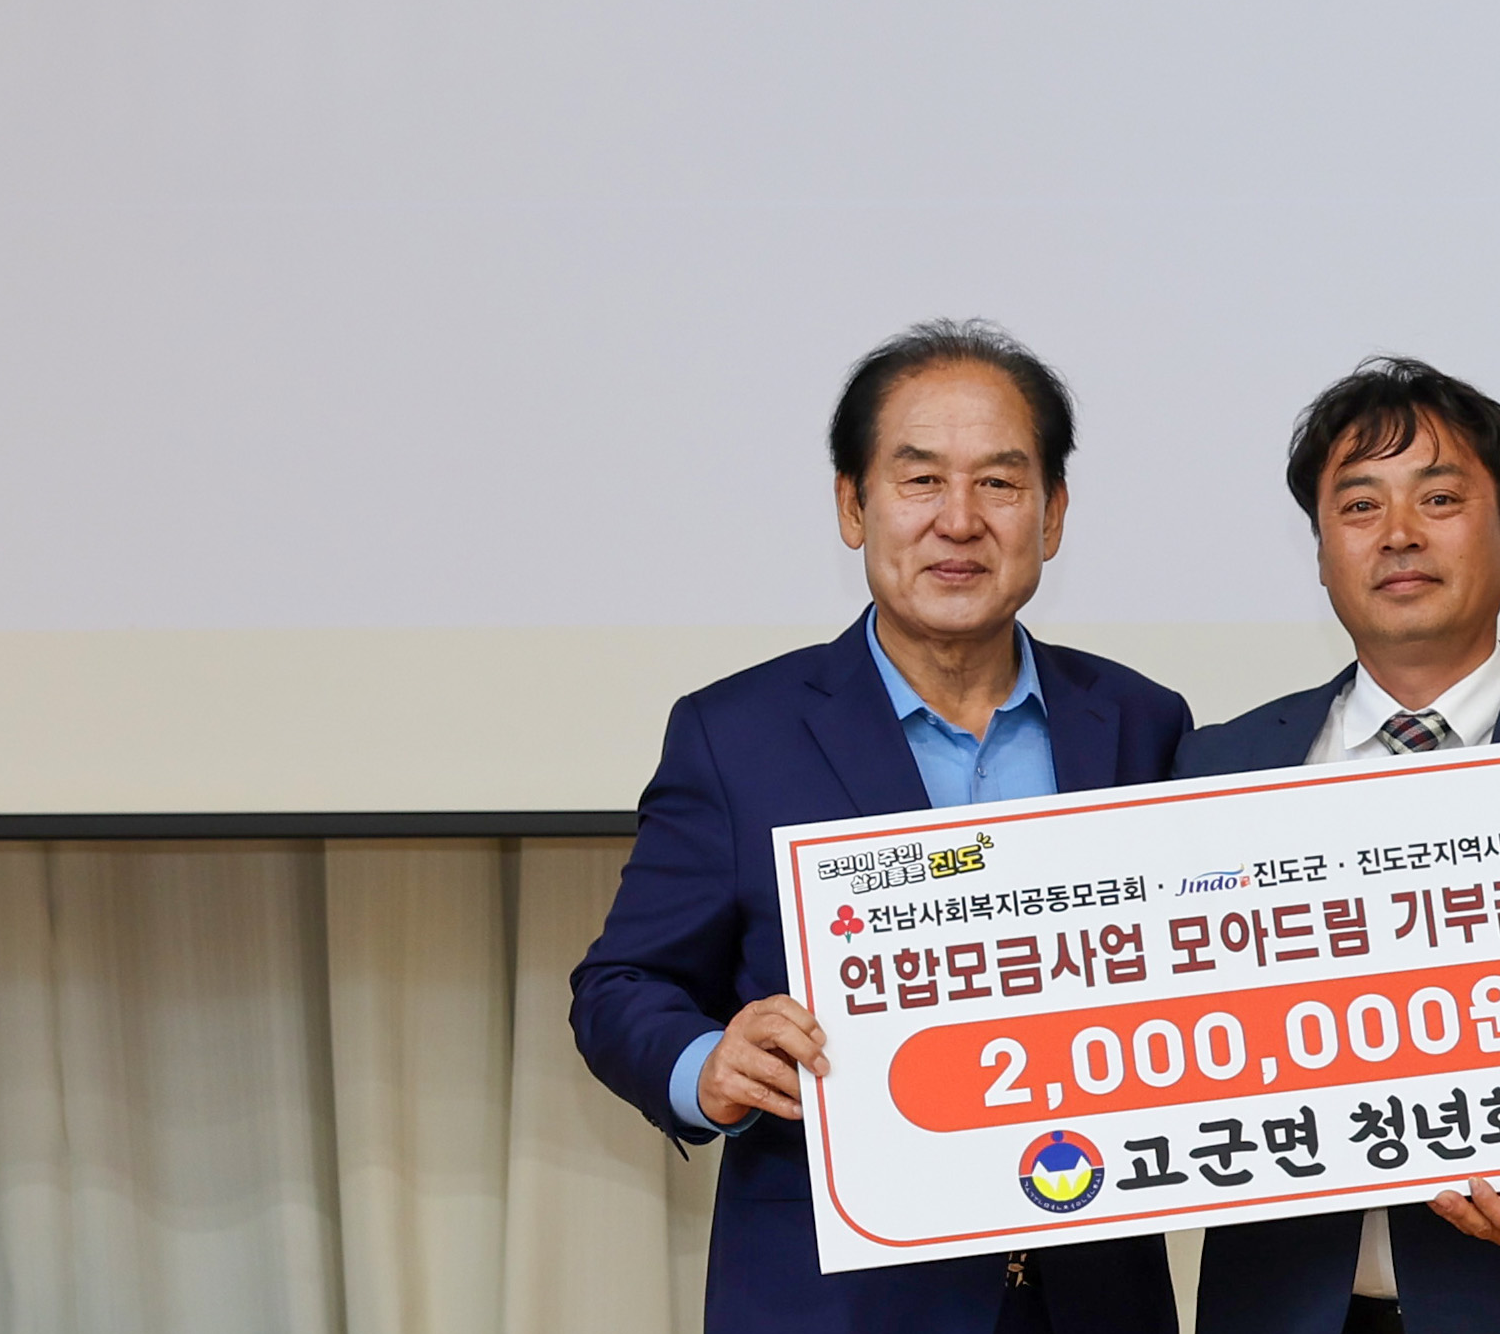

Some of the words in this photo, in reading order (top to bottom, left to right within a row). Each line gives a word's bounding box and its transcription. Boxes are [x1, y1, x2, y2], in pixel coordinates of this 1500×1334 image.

[818, 851, 875, 880] 군민이
[878, 842, 923, 866] 주인!
[850, 865, 925, 895] 살기좋은
[928, 844, 986, 878] 진도
[868, 876, 1147, 935] 전남사회복지공동모금회
[1253, 855, 1328, 889] 진도군
[839, 923, 1147, 1016] 연합모금사업
[1169, 896, 1371, 977] 모아드림
[1116, 1104, 1326, 1191] 고군면
